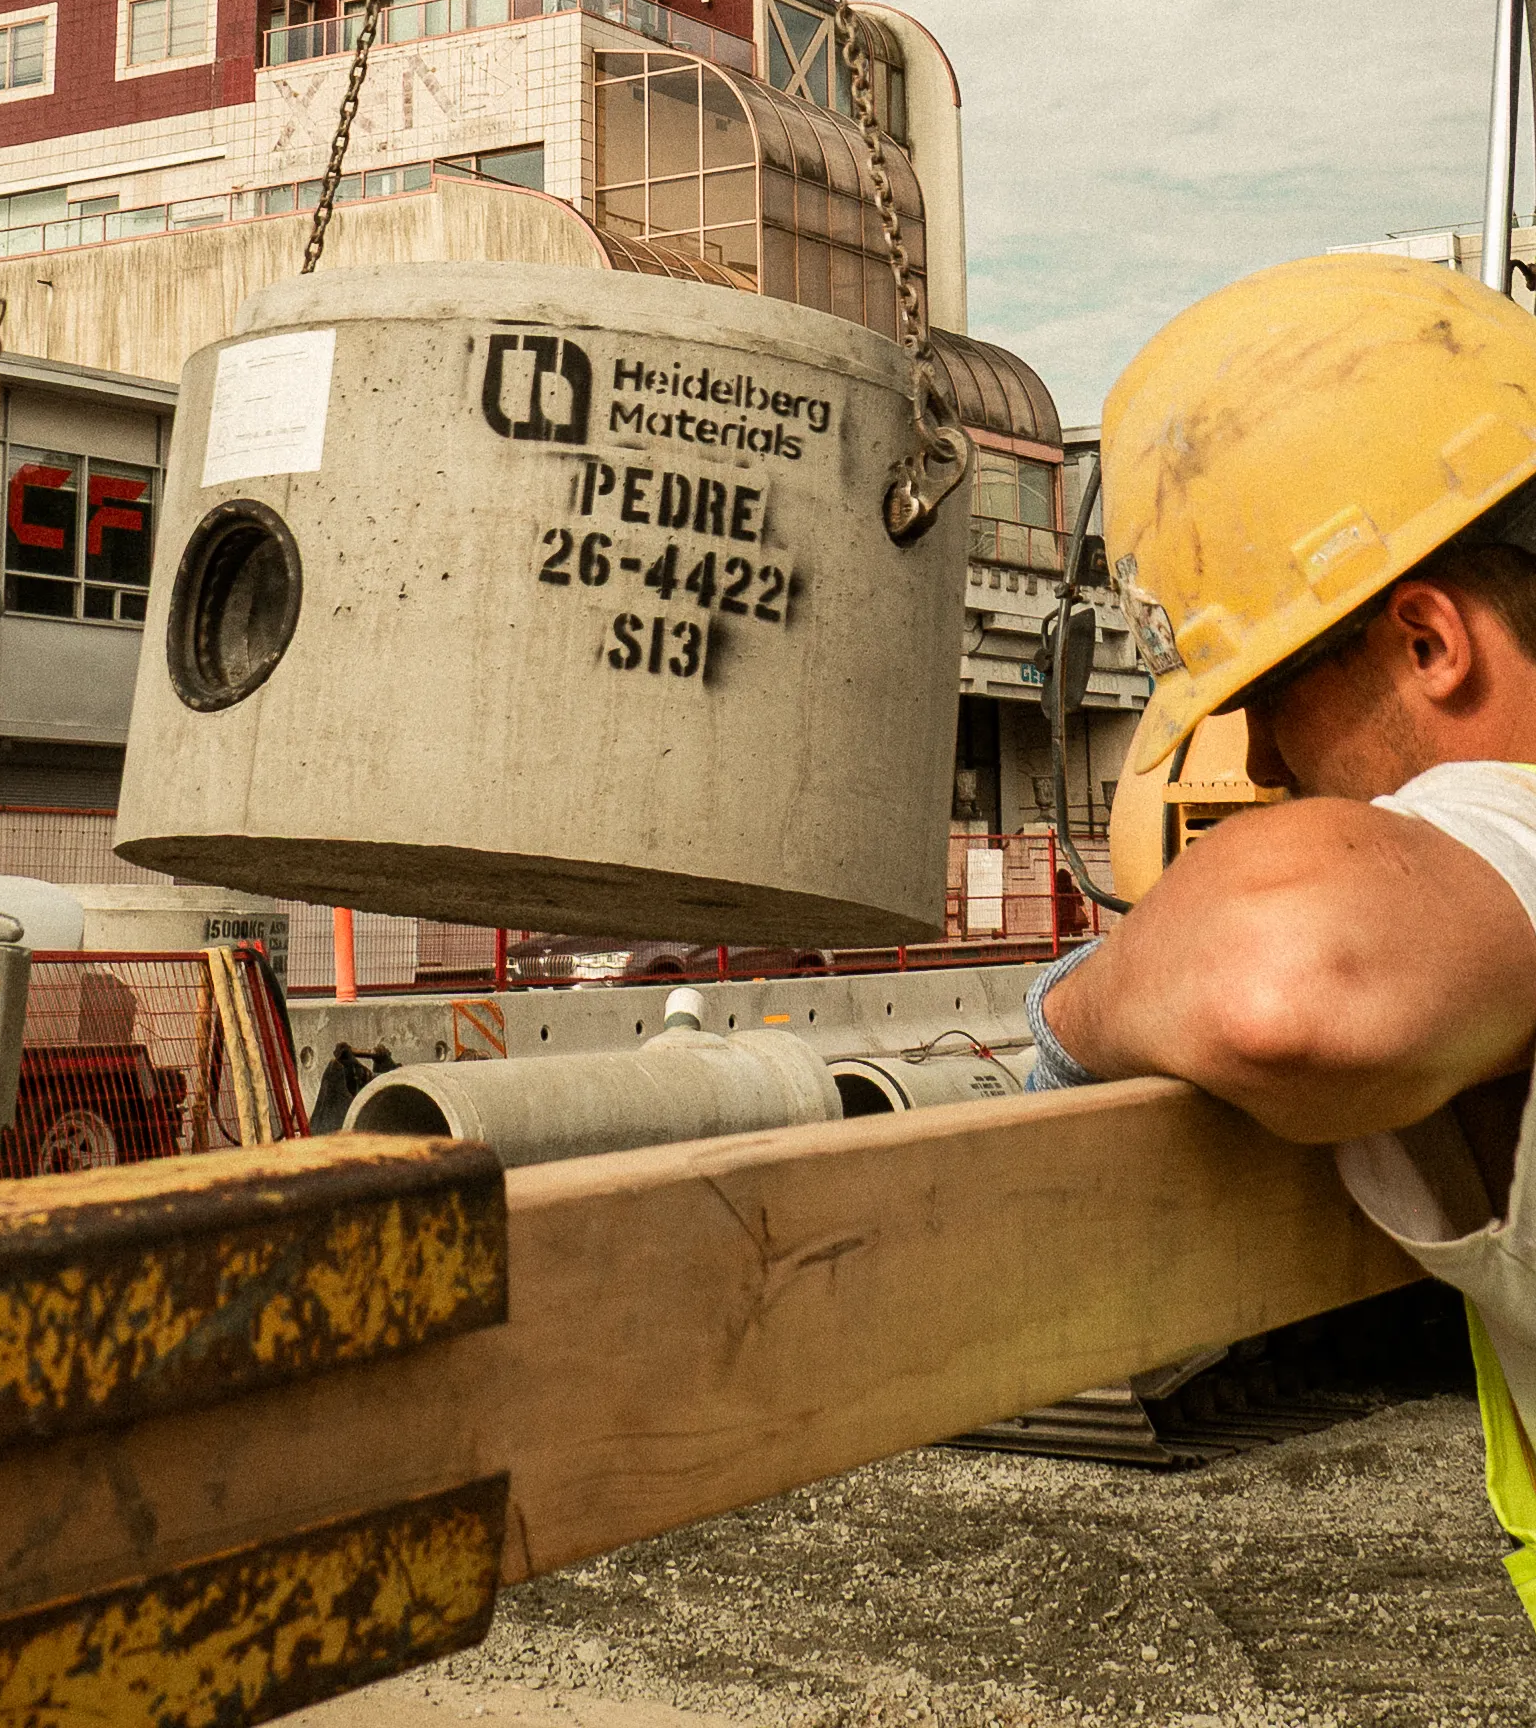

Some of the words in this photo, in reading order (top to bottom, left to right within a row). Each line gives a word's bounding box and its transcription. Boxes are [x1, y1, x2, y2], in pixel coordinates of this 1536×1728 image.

[609, 400, 803, 461] Materials
[613, 358, 832, 434] Heidelberg
[580, 462, 761, 543] PEDRE
[539, 528, 785, 622] 26-4422
